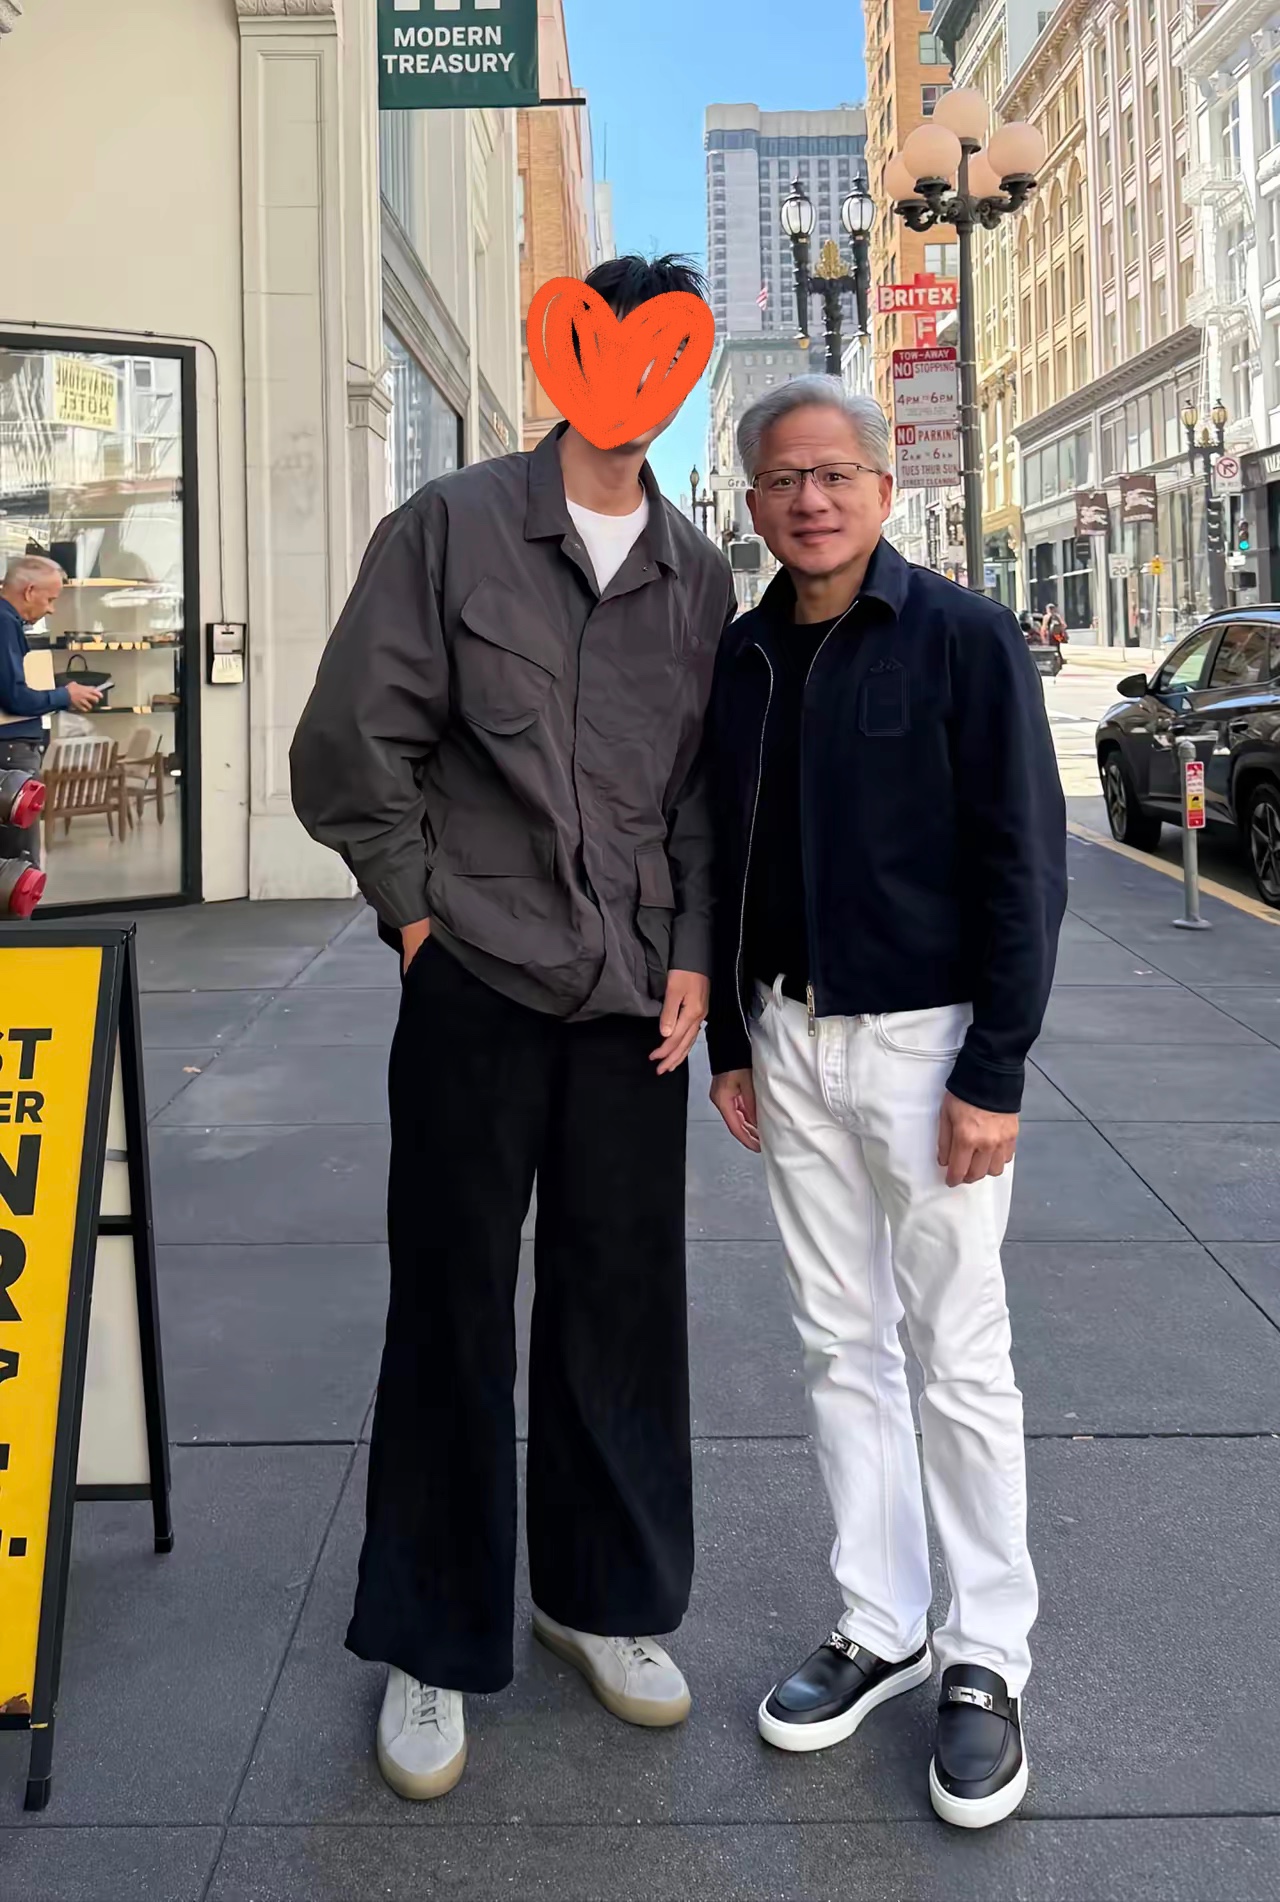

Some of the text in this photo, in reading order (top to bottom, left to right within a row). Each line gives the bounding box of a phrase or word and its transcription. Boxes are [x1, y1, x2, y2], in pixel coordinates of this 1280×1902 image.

[394, 26, 502, 48] MODERN
[382, 53, 516, 74] TREASURY
[880, 287, 954, 311] BRITEX
[917, 317, 935, 348] F
[899, 349, 950, 361] TOW-AWAY
[894, 362, 955, 377] NO STOPPING
[897, 427, 957, 444] NO PARKING
[727, 478, 747, 488] Gra
[1112, 566, 1127, 576] 20
